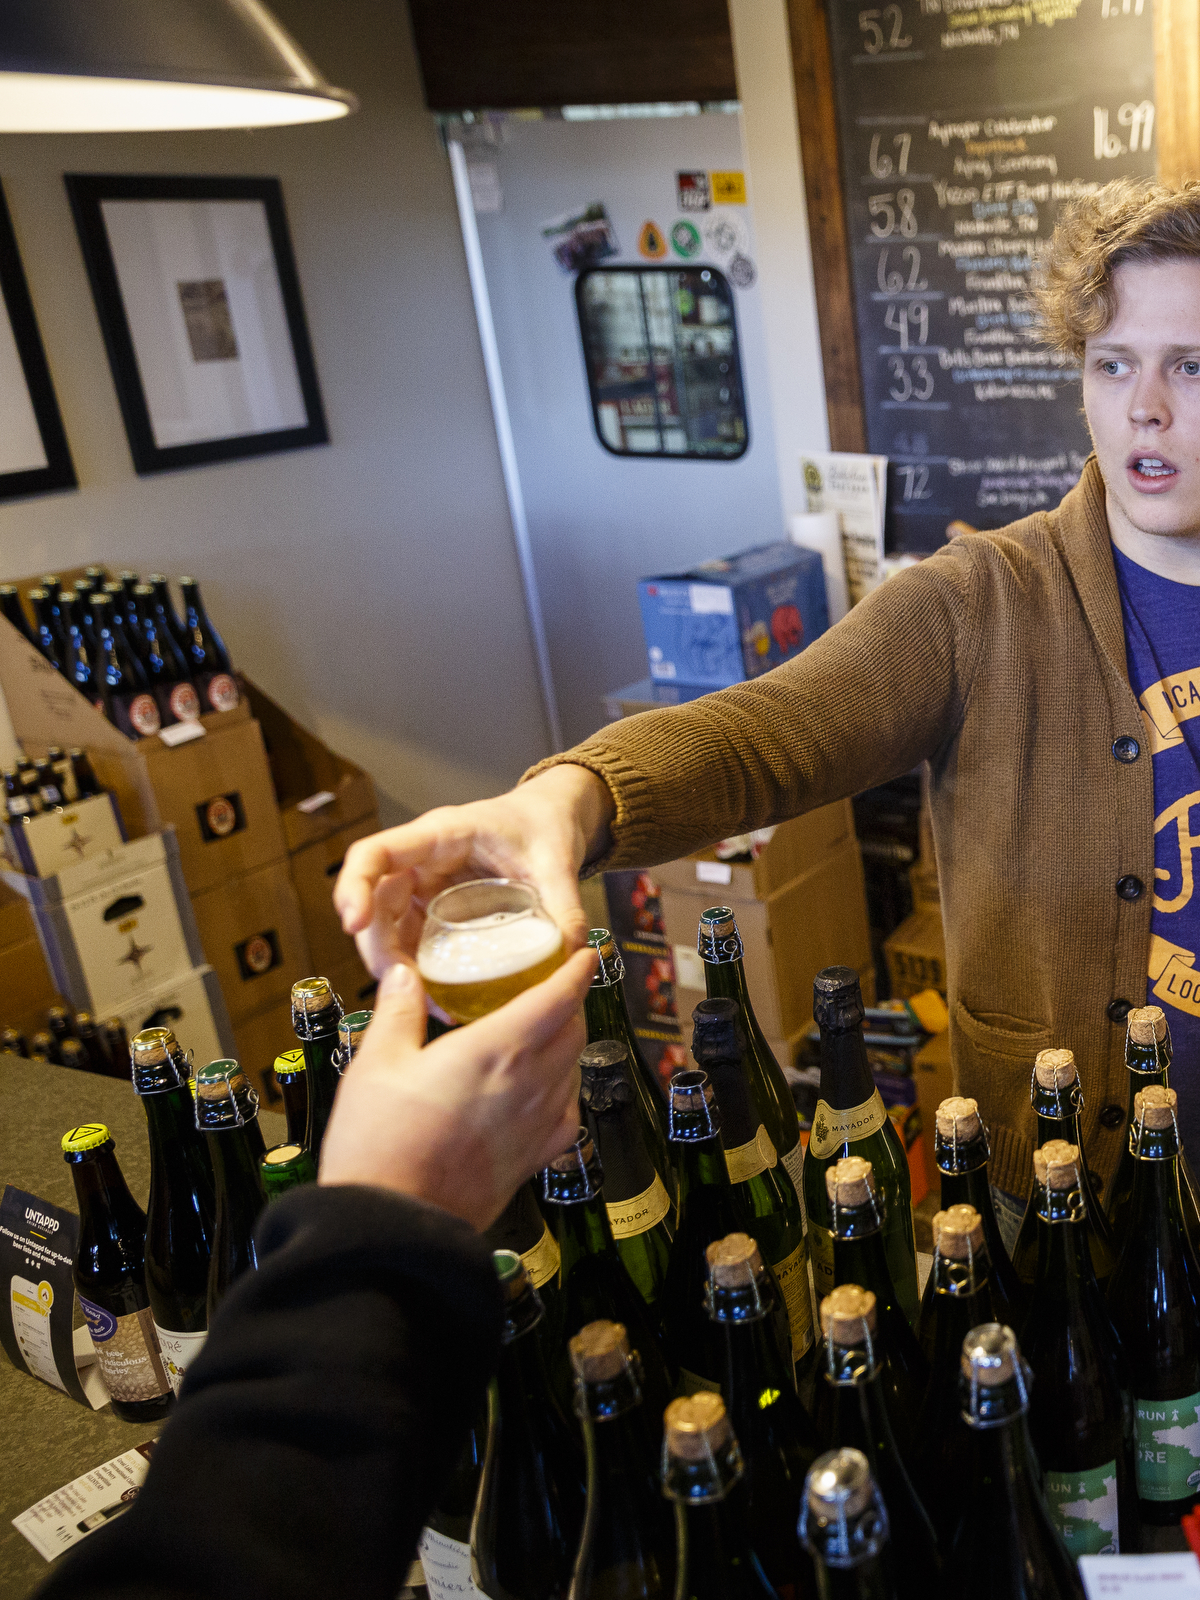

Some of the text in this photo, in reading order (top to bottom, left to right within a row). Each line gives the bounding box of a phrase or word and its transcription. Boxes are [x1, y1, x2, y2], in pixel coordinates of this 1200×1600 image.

[832, 1113, 875, 1132] MAYADOR
[25, 1207, 60, 1233] UNTAPPD
[611, 1208, 649, 1225] YADOR
[12, 1240, 23, 1250] beer
[22, 1244, 32, 1255] lists
[32, 1249, 41, 1259] and
[26, 1238, 45, 1253] Untappd
[1138, 1409, 1166, 1421] RUN
[1050, 1483, 1072, 1494] UN
